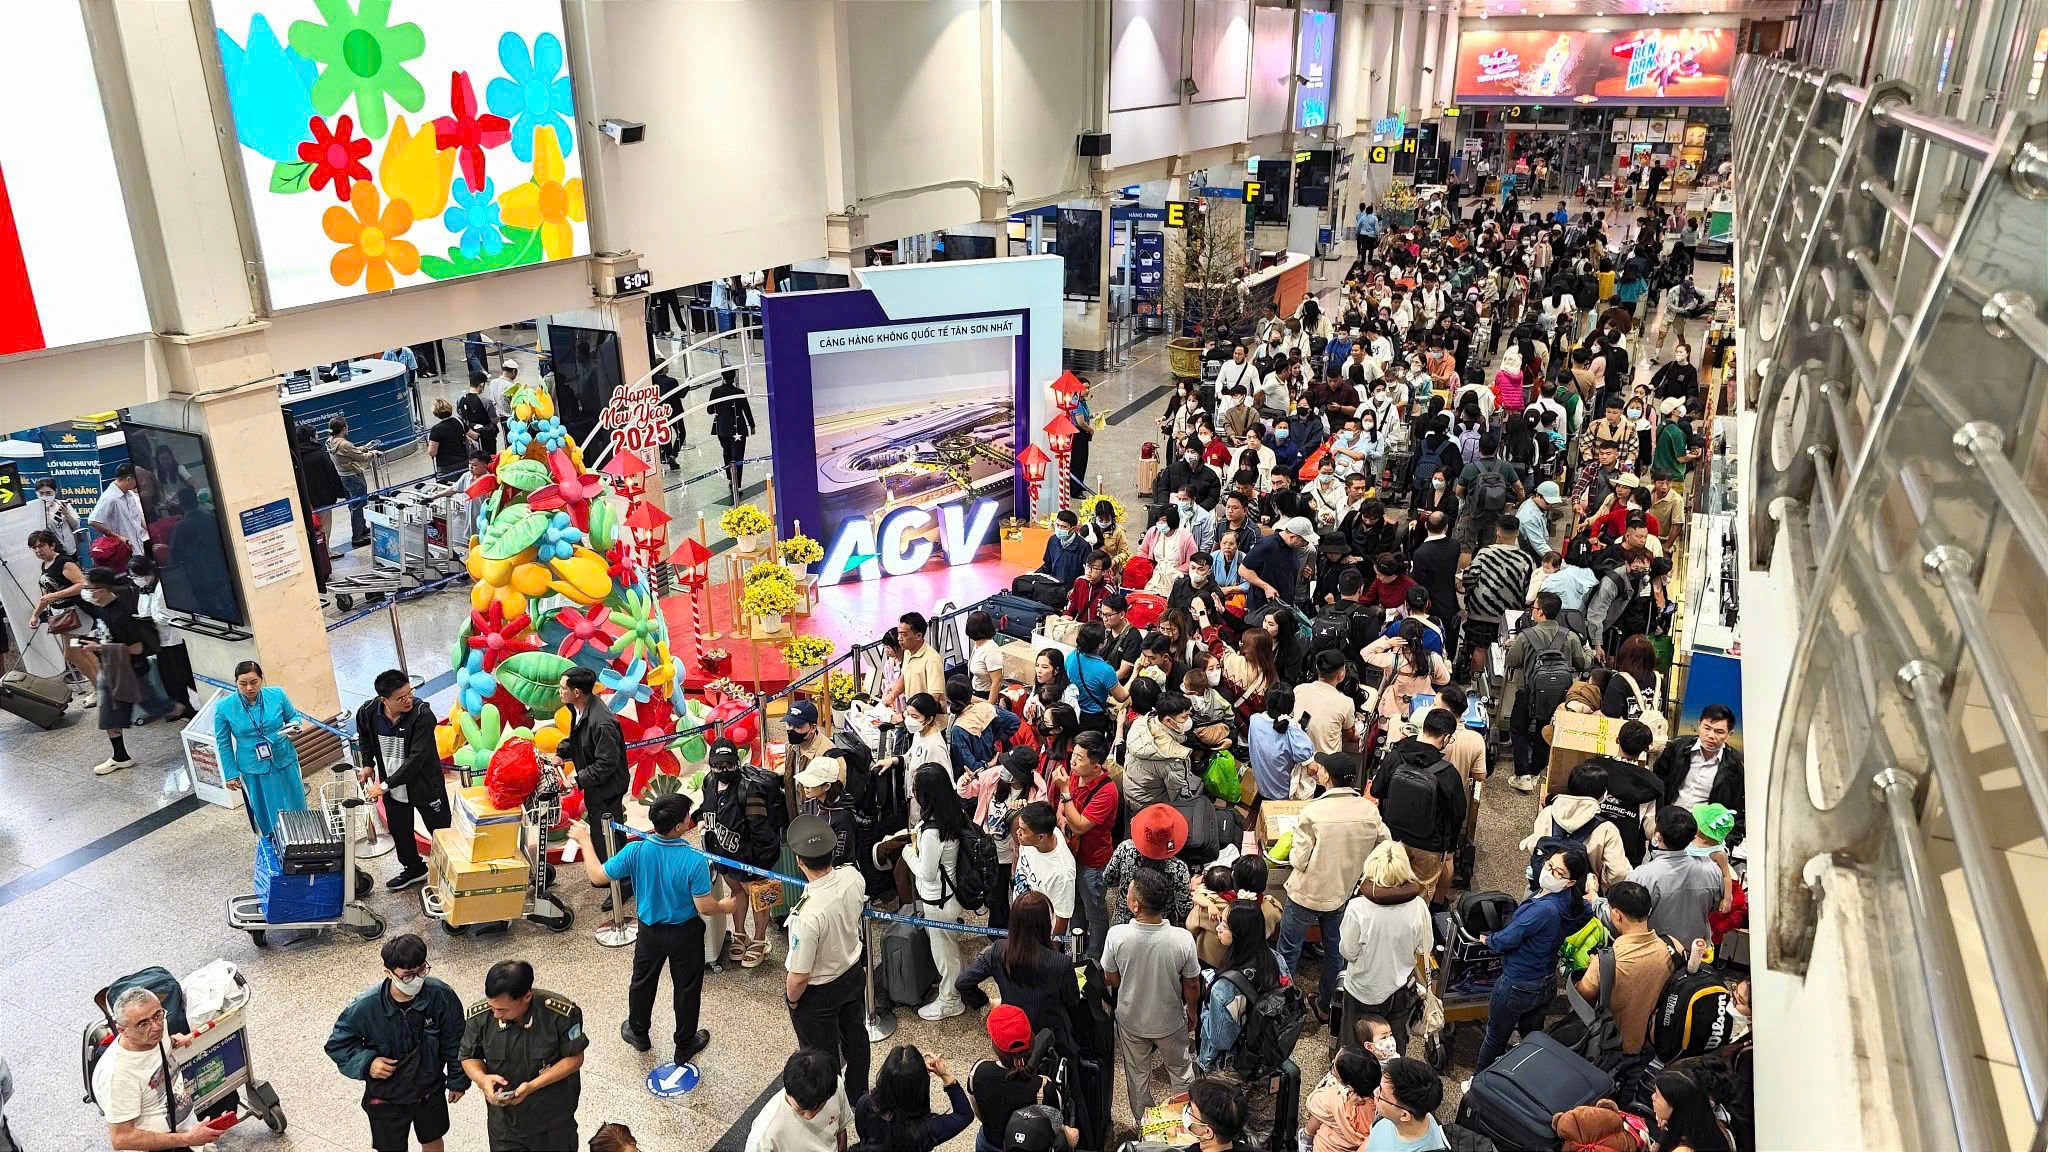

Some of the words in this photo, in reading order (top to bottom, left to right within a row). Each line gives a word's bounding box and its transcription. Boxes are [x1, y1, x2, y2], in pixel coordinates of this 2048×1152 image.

[1373, 147, 1385, 162] G
[1404, 138, 1415, 153] H
[1247, 183, 1261, 202] F
[1169, 204, 1184, 226] E
[624, 273, 649, 290] 5:04
[819, 334, 846, 348] CẢNG
[849, 332, 874, 345] HÀNG
[877, 330, 909, 343] KHÔNG
[911, 326, 936, 341] QUỐC
[938, 324, 949, 337] TẾ
[951, 324, 968, 336] TÂN
[970, 324, 988, 335] SƠN
[990, 319, 1014, 332] NHẤT
[610, 385, 661, 408] Happy
[601, 407, 632, 429] New
[633, 403, 672, 430] Year
[612, 419, 671, 456] 2025
[818, 496, 1000, 589] ACV
[369, 604, 381, 613] TIA
[615, 823, 629, 832] TIA
[739, 863, 755, 874] TIA
[873, 911, 892, 920] TIA
[1664, 993, 1679, 1027] Wilson
[1704, 994, 1727, 1050] Wilson
